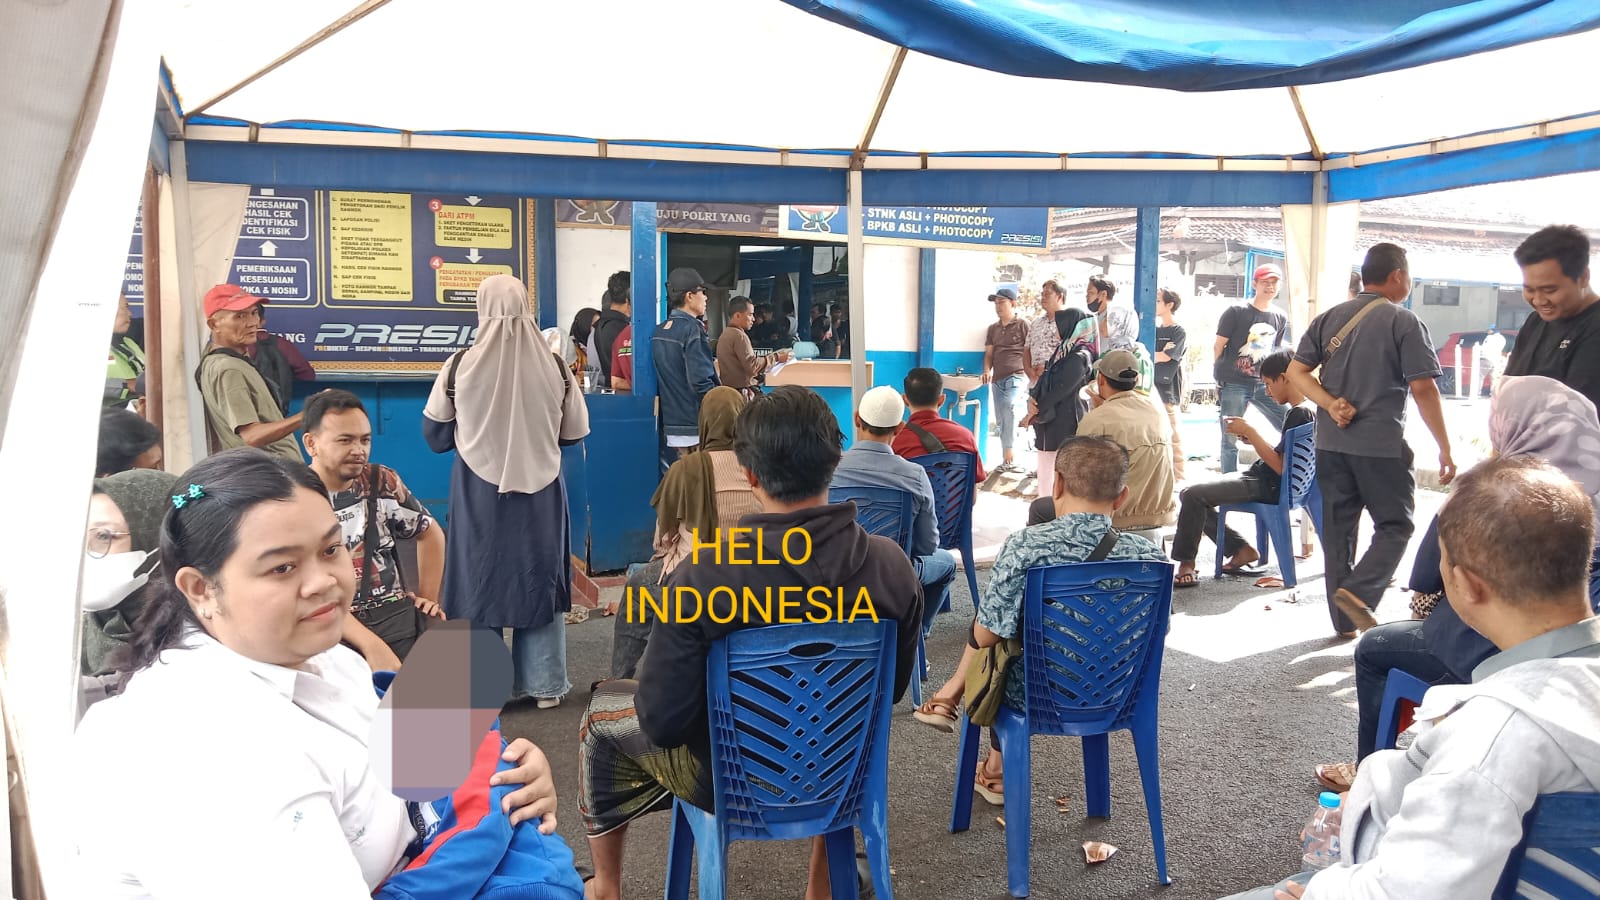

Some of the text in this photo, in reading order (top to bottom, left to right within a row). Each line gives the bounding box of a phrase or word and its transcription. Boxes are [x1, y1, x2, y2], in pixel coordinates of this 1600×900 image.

[681, 210, 717, 222] POLRI
[719, 213, 751, 223] YANG
[867, 208, 896, 220] STNK
[899, 210, 922, 221] ASLI
[933, 212, 994, 227] PHOTOCOPY
[267, 228, 291, 236] FISIK
[867, 220, 896, 231] BPKB
[898, 223, 922, 233] ASLI
[933, 223, 993, 239] PHOTOCOPY
[1000, 233, 1043, 242] PRESISI
[433, 259, 440, 268] 4
[236, 264, 297, 273] PEMERIKSAAN
[240, 275, 293, 284] KESESUAIAN
[262, 286, 269, 294] &
[271, 286, 298, 295] NOSIN
